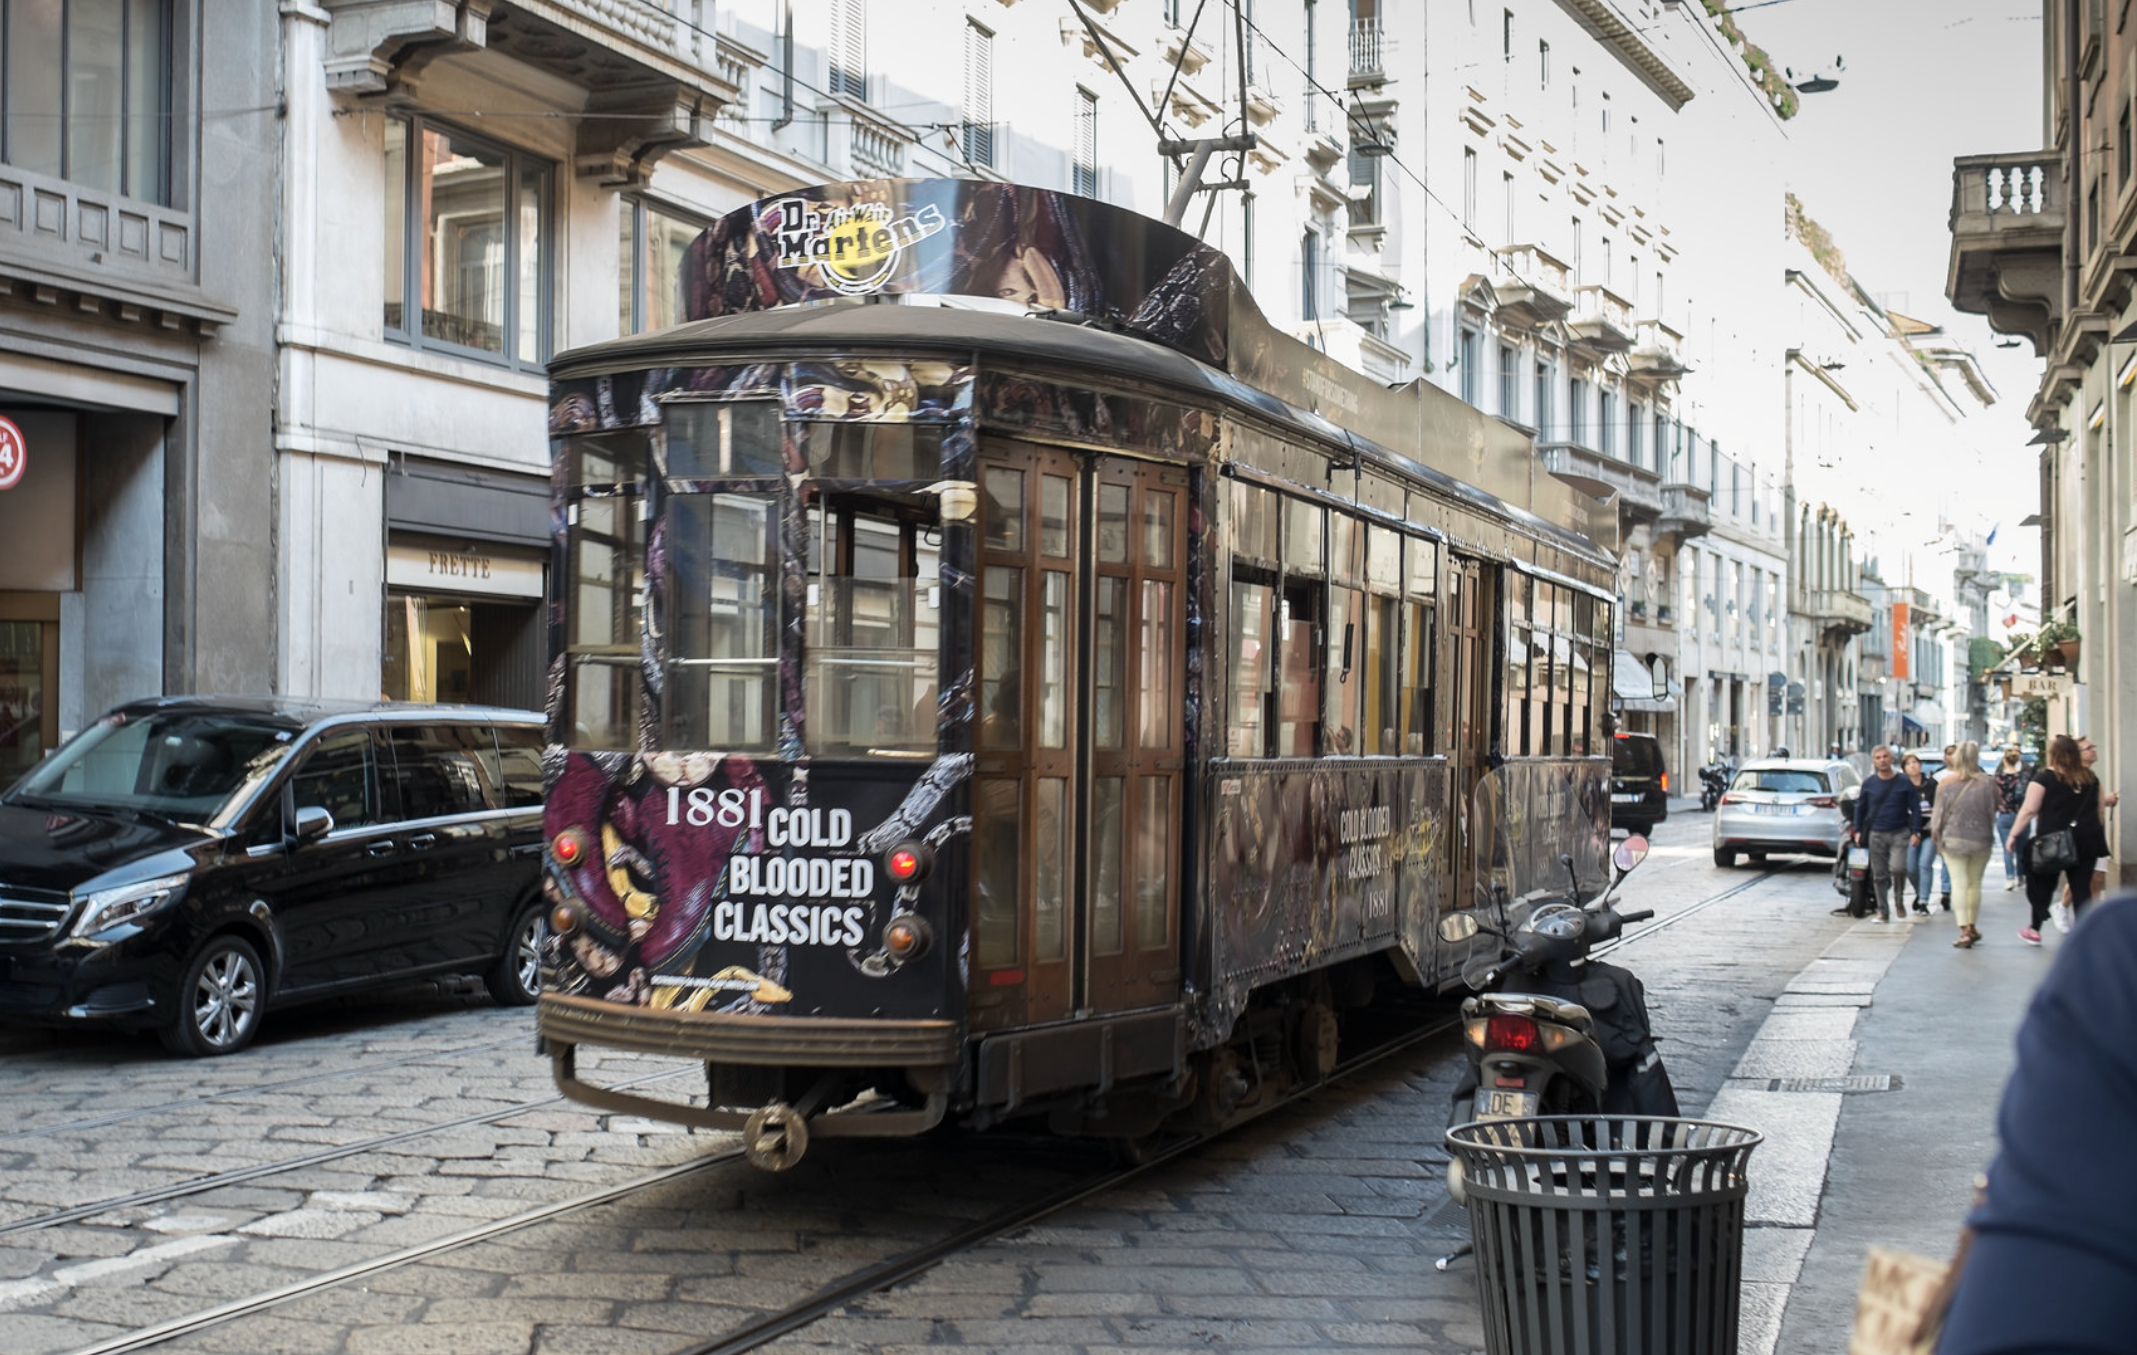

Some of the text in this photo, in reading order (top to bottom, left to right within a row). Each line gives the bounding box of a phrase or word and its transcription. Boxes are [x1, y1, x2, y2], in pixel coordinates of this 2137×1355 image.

[781, 200, 820, 232] Dr
[779, 204, 945, 267] Martens
[429, 552, 490, 578] FRETTE
[2029, 680, 2057, 690] BAR
[666, 787, 762, 828] 1881
[767, 807, 852, 847] COLD
[729, 855, 874, 898] BLOODED
[1368, 889, 1388, 918] 1881
[713, 901, 865, 946] CLASSICS
[1491, 1093, 1513, 1115] DE
